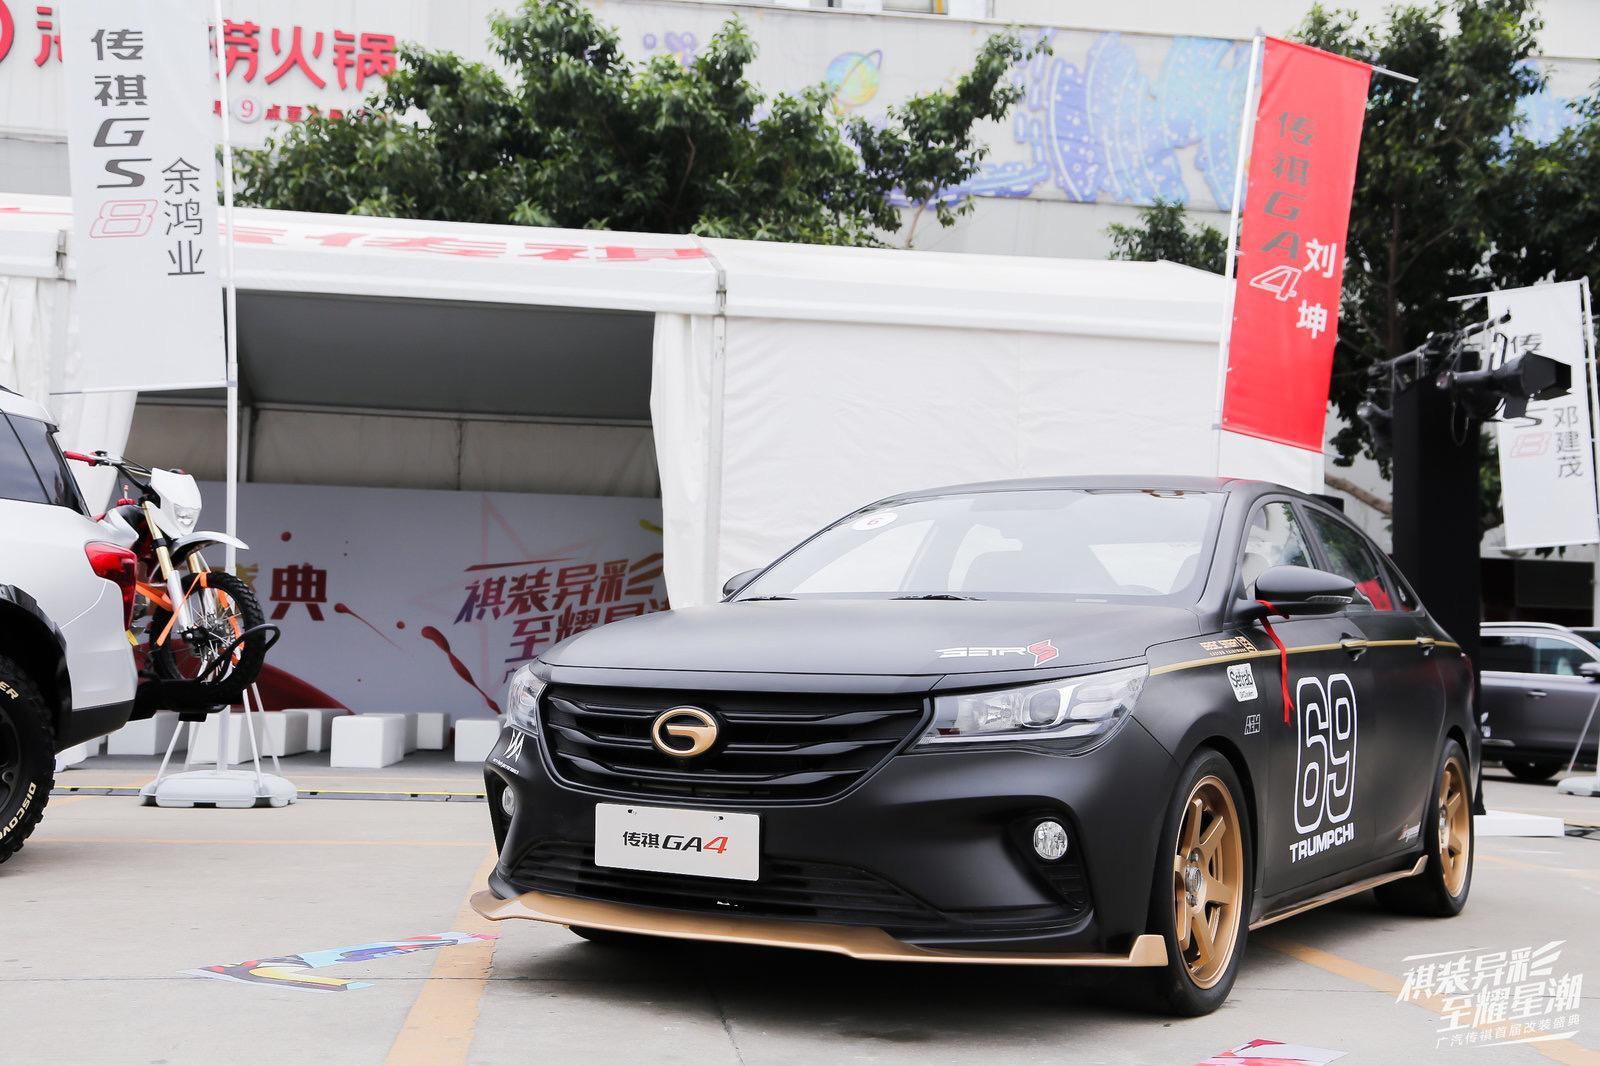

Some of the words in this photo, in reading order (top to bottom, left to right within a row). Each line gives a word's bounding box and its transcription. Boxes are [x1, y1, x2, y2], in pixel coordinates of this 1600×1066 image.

[162, 157, 205, 276] 余鸿业
[1296, 238, 1338, 340] 刘坤
[1552, 405, 1584, 479] 邓建茂
[454, 553, 664, 625] 祺装异彩
[1293, 673, 1358, 835] 69
[0, 782, 37, 840] DISCOV
[1289, 822, 1355, 863] TRUMPCHI
